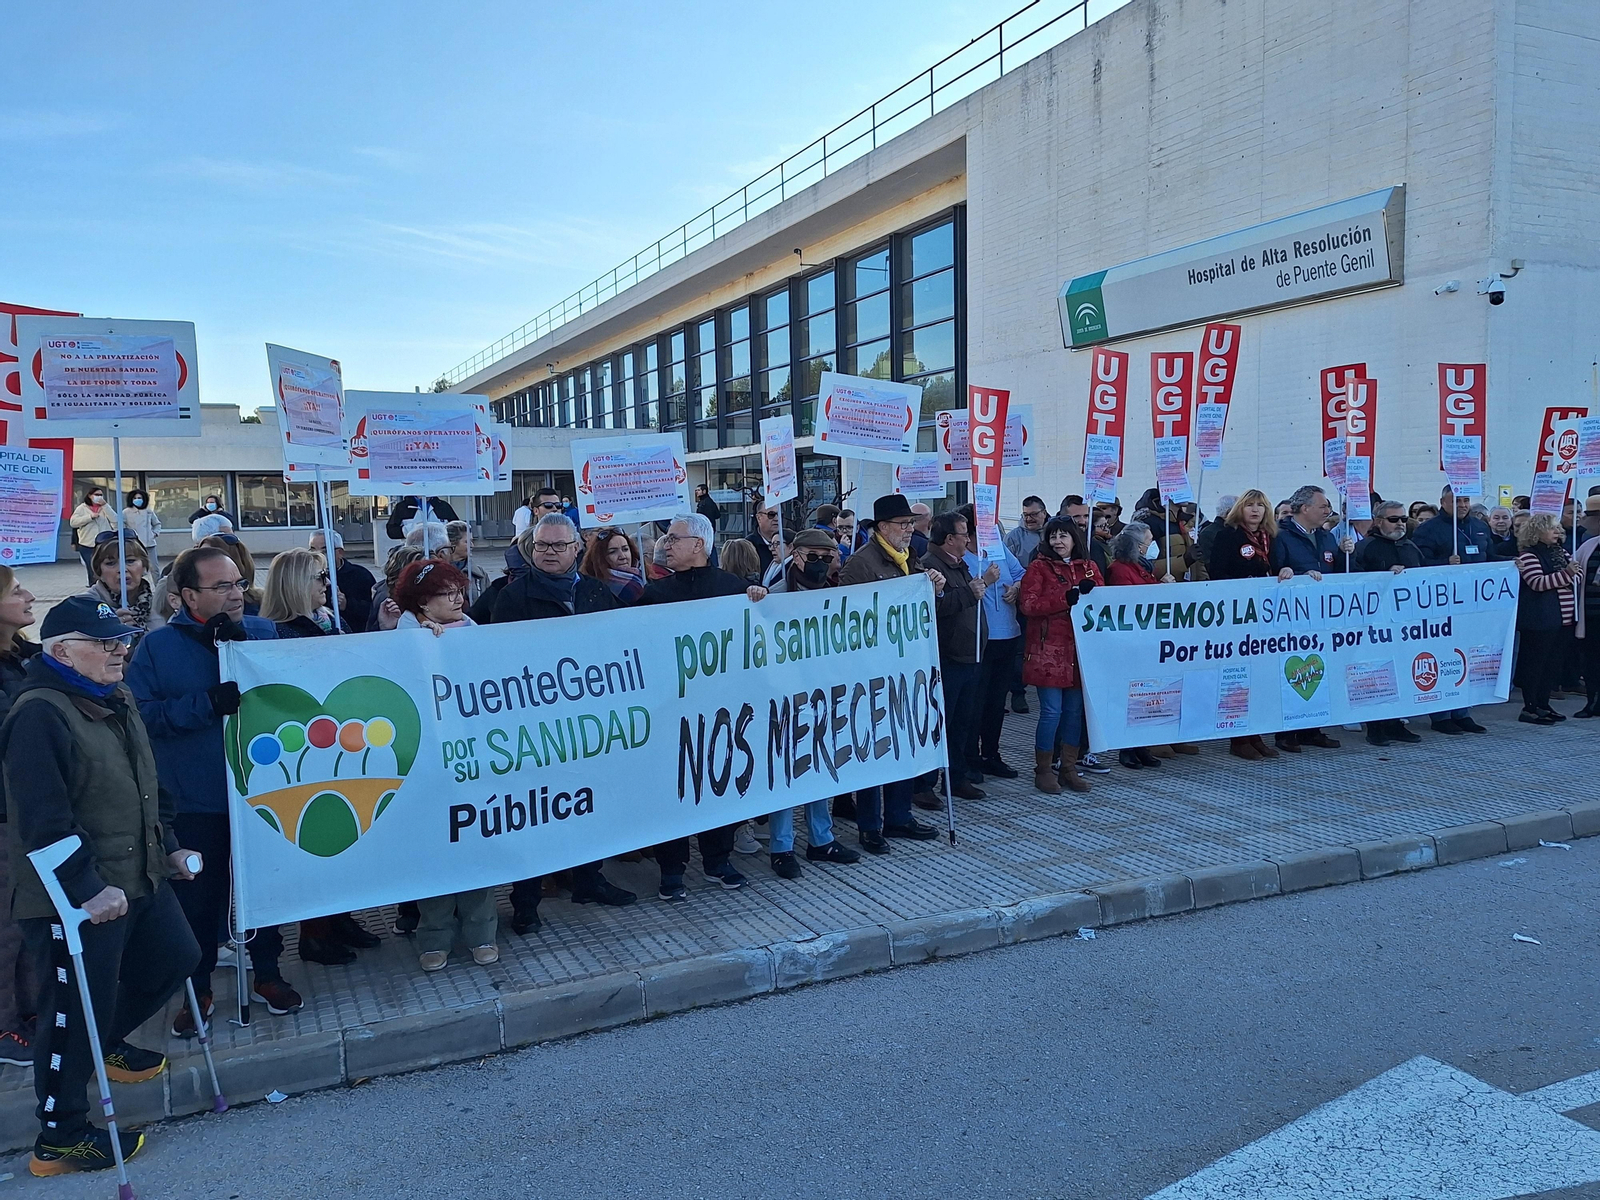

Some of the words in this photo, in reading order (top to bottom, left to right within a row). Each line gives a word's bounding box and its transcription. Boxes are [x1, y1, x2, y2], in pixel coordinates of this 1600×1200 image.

[1188, 262, 1235, 286] Hospital
[1241, 256, 1256, 270] de
[1262, 248, 1288, 267] Alta
[1294, 226, 1372, 260] Resolución
[1276, 270, 1291, 288] de
[1295, 260, 1337, 285] Puente
[1341, 250, 1375, 274] Genil
[1092, 353, 1120, 435] UGT
[1201, 329, 1232, 404] UGT
[1156, 358, 1184, 437] UGT
[1347, 383, 1368, 456] UGT
[1446, 368, 1475, 436] UGT
[32, 454, 46, 463] DE
[972, 392, 998, 485] UGT
[1561, 434, 1577, 446] UGT
[22, 465, 52, 475] GENIL
[1081, 598, 1225, 633] SALVEMOS
[1232, 597, 1258, 625] LA
[1159, 640, 1199, 663] Por
[1204, 639, 1233, 660] tus
[1238, 632, 1325, 657] derechos,
[1332, 631, 1363, 652] por
[1367, 625, 1393, 644] tu
[1401, 616, 1452, 642] salud
[674, 628, 733, 698] por
[743, 608, 767, 670] la
[773, 591, 879, 665] sanidad
[886, 600, 930, 658] que
[1415, 657, 1435, 672] UGT
[1440, 659, 1462, 668] Servicios
[1440, 668, 1461, 677] Públicos
[431, 648, 646, 720] PuenteGenil
[442, 736, 477, 768] por
[454, 758, 480, 783] su
[486, 705, 651, 775] SANIDAD
[678, 702, 754, 806] NOS
[767, 665, 944, 792] MERECEMOS
[449, 786, 595, 843] Pública
